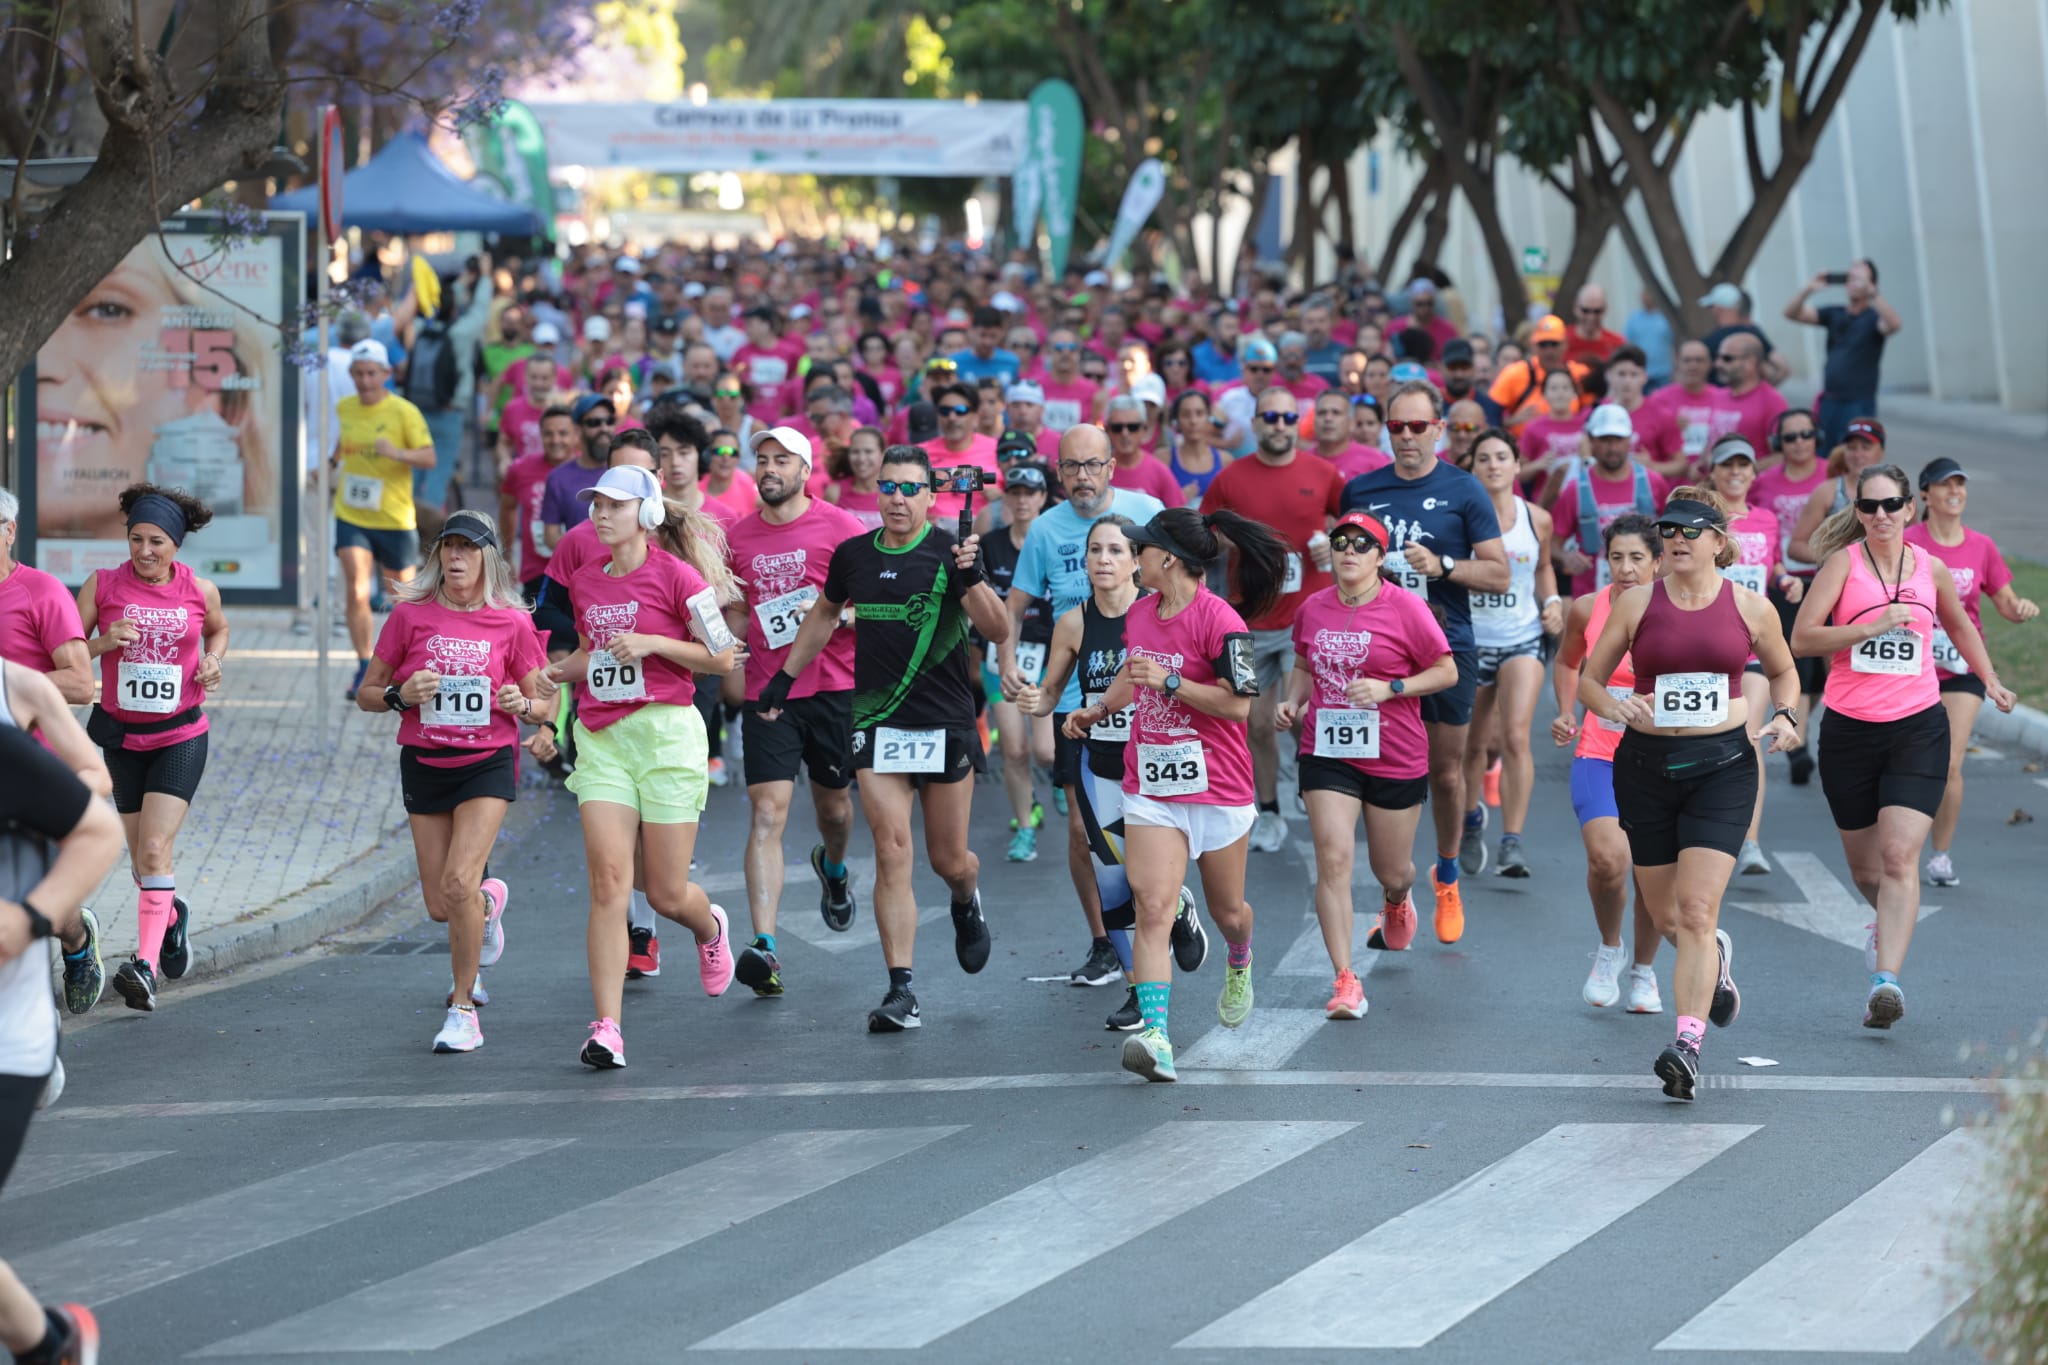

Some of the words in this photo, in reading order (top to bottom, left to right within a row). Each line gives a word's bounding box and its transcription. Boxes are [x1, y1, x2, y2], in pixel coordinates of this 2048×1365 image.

[161, 330, 238, 390] 15
[1472, 592, 1516, 608] 390
[1860, 640, 1914, 660] 469
[592, 665, 636, 688] 670
[126, 680, 175, 700] 109
[433, 693, 483, 712] 110
[1664, 691, 1718, 711] 631
[1324, 726, 1369, 745] 191
[883, 742, 936, 760] 217
[1145, 760, 1199, 783] 343
